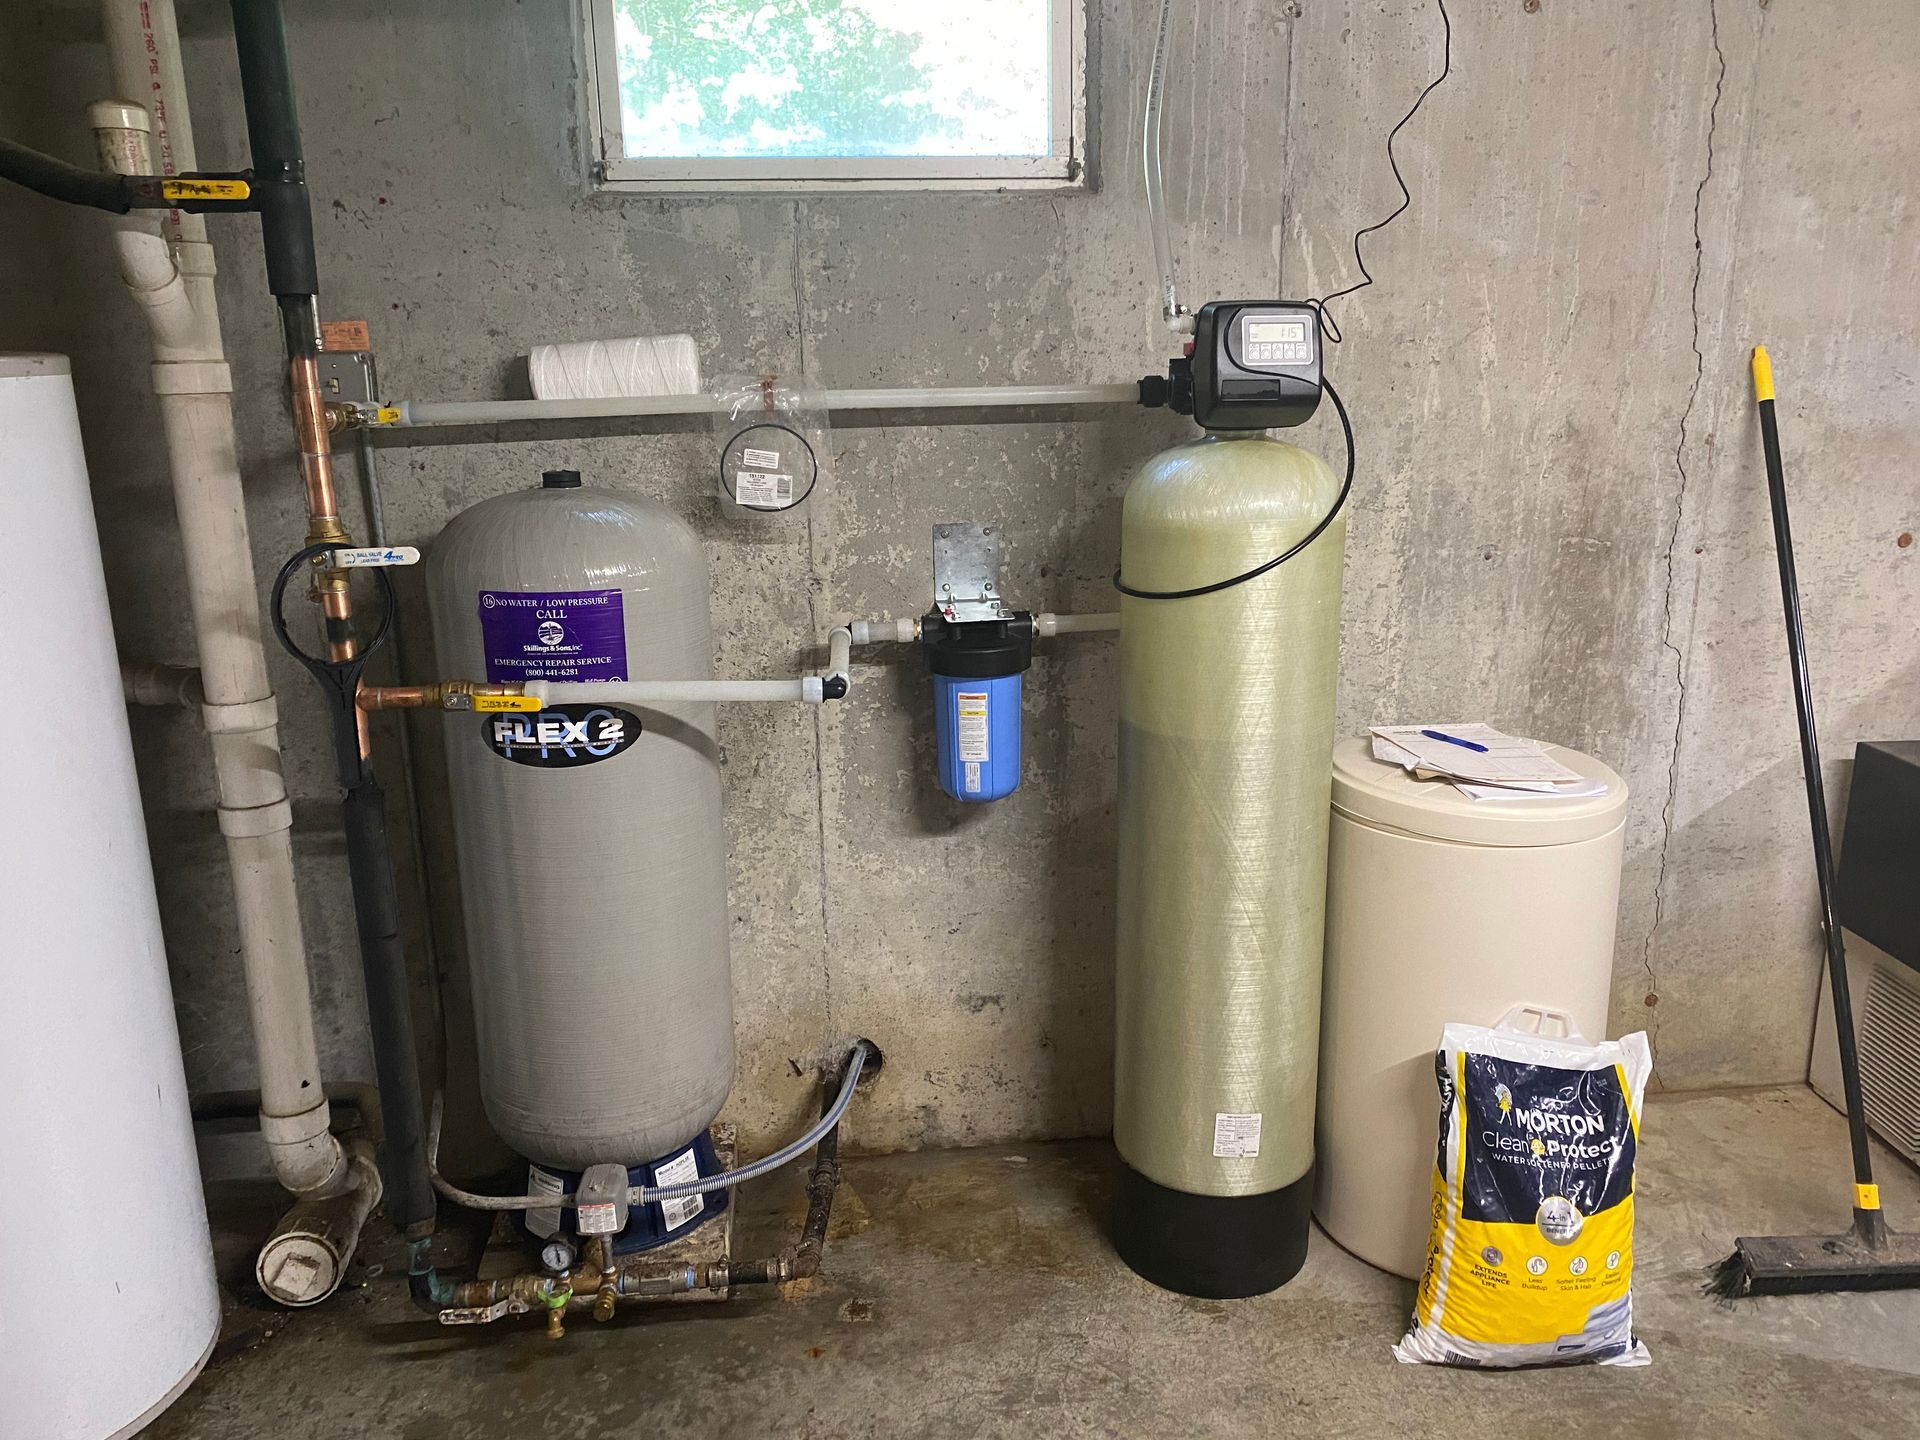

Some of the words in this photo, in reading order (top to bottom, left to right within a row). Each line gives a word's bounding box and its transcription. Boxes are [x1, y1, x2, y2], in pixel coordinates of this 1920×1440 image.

[508, 599, 537, 607] WATER
[568, 597, 609, 606] PRESSURE
[536, 609, 567, 619] CALL
[523, 644, 550, 653] Skillings
[495, 658, 544, 667] EMERGENCY
[545, 658, 577, 667] REPAIR
[577, 656, 612, 665] SERVICE
[525, 668, 544, 677] (800)
[545, 668, 579, 677] 441-6281
[494, 721, 590, 743] FLEX
[598, 718, 625, 740] 2
[1515, 1107, 1605, 1136] MORTON
[1482, 1131, 1530, 1154] Clean
[1547, 1135, 1619, 1159] Protect
[1492, 1153, 1529, 1165] WATER
[1474, 1264, 1508, 1279] EXTENDS
[1470, 1269, 1511, 1286] APPLIANCE
[1481, 1280, 1497, 1289] LIFE
